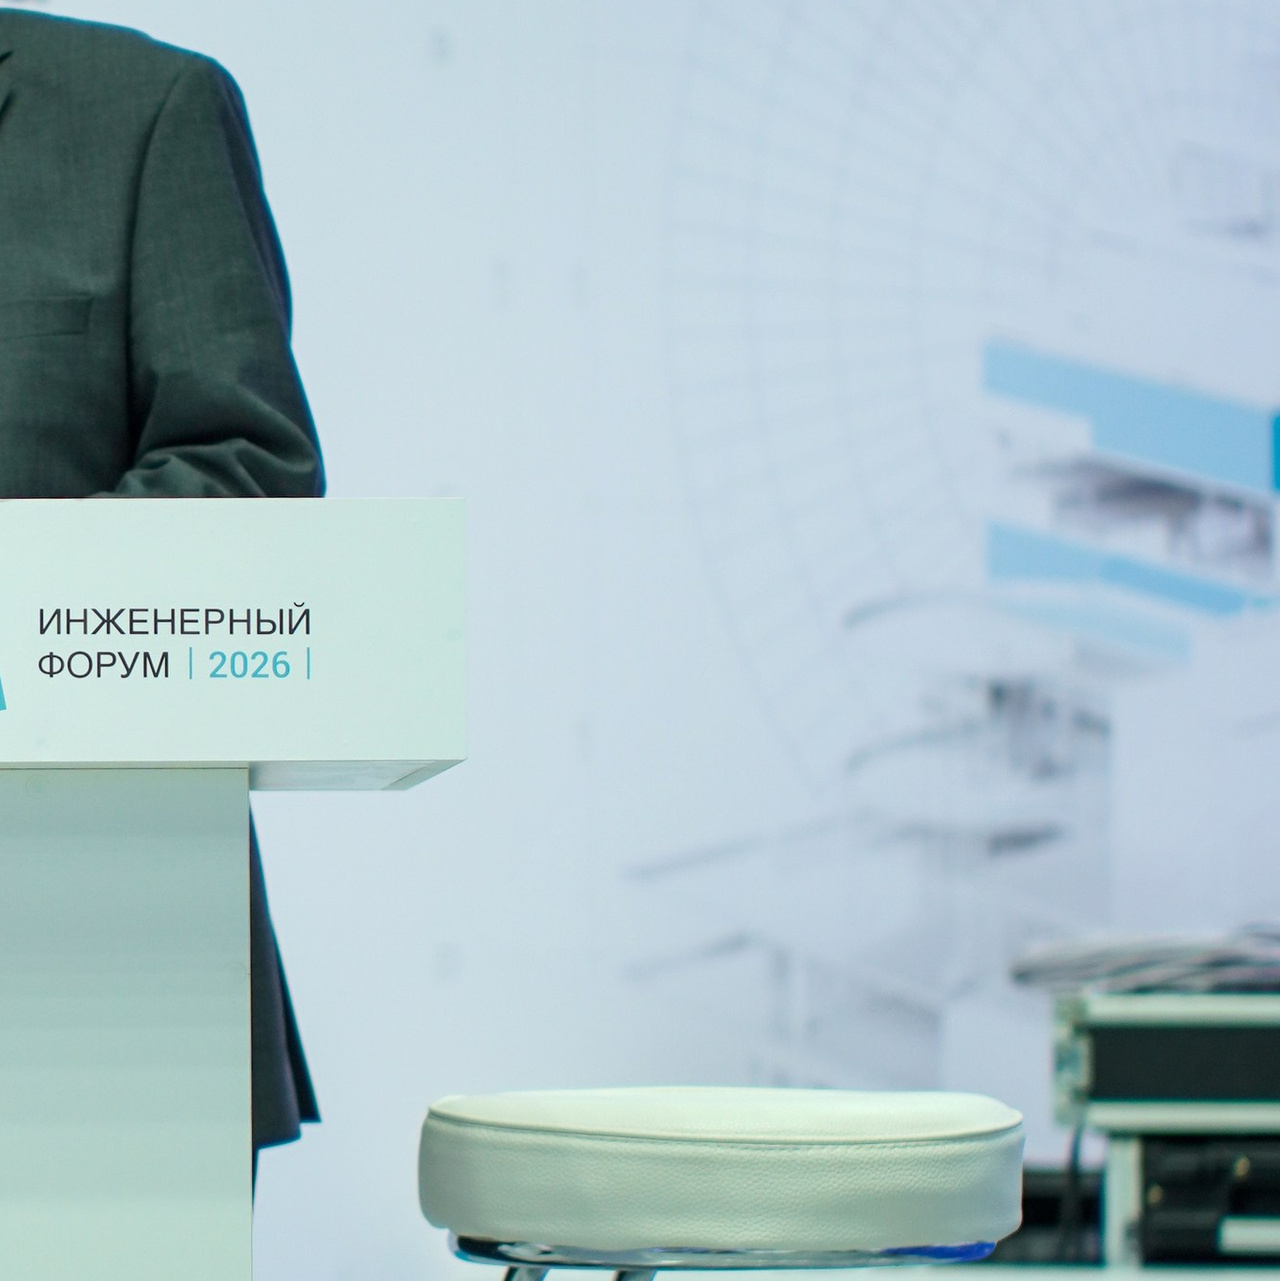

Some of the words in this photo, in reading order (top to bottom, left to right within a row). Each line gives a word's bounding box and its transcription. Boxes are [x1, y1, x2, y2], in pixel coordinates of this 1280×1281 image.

[38, 601, 311, 636] ИНЖЕНЕРНЫЙ
[37, 650, 170, 680] ФОРУМ
[208, 650, 291, 679] 2026
